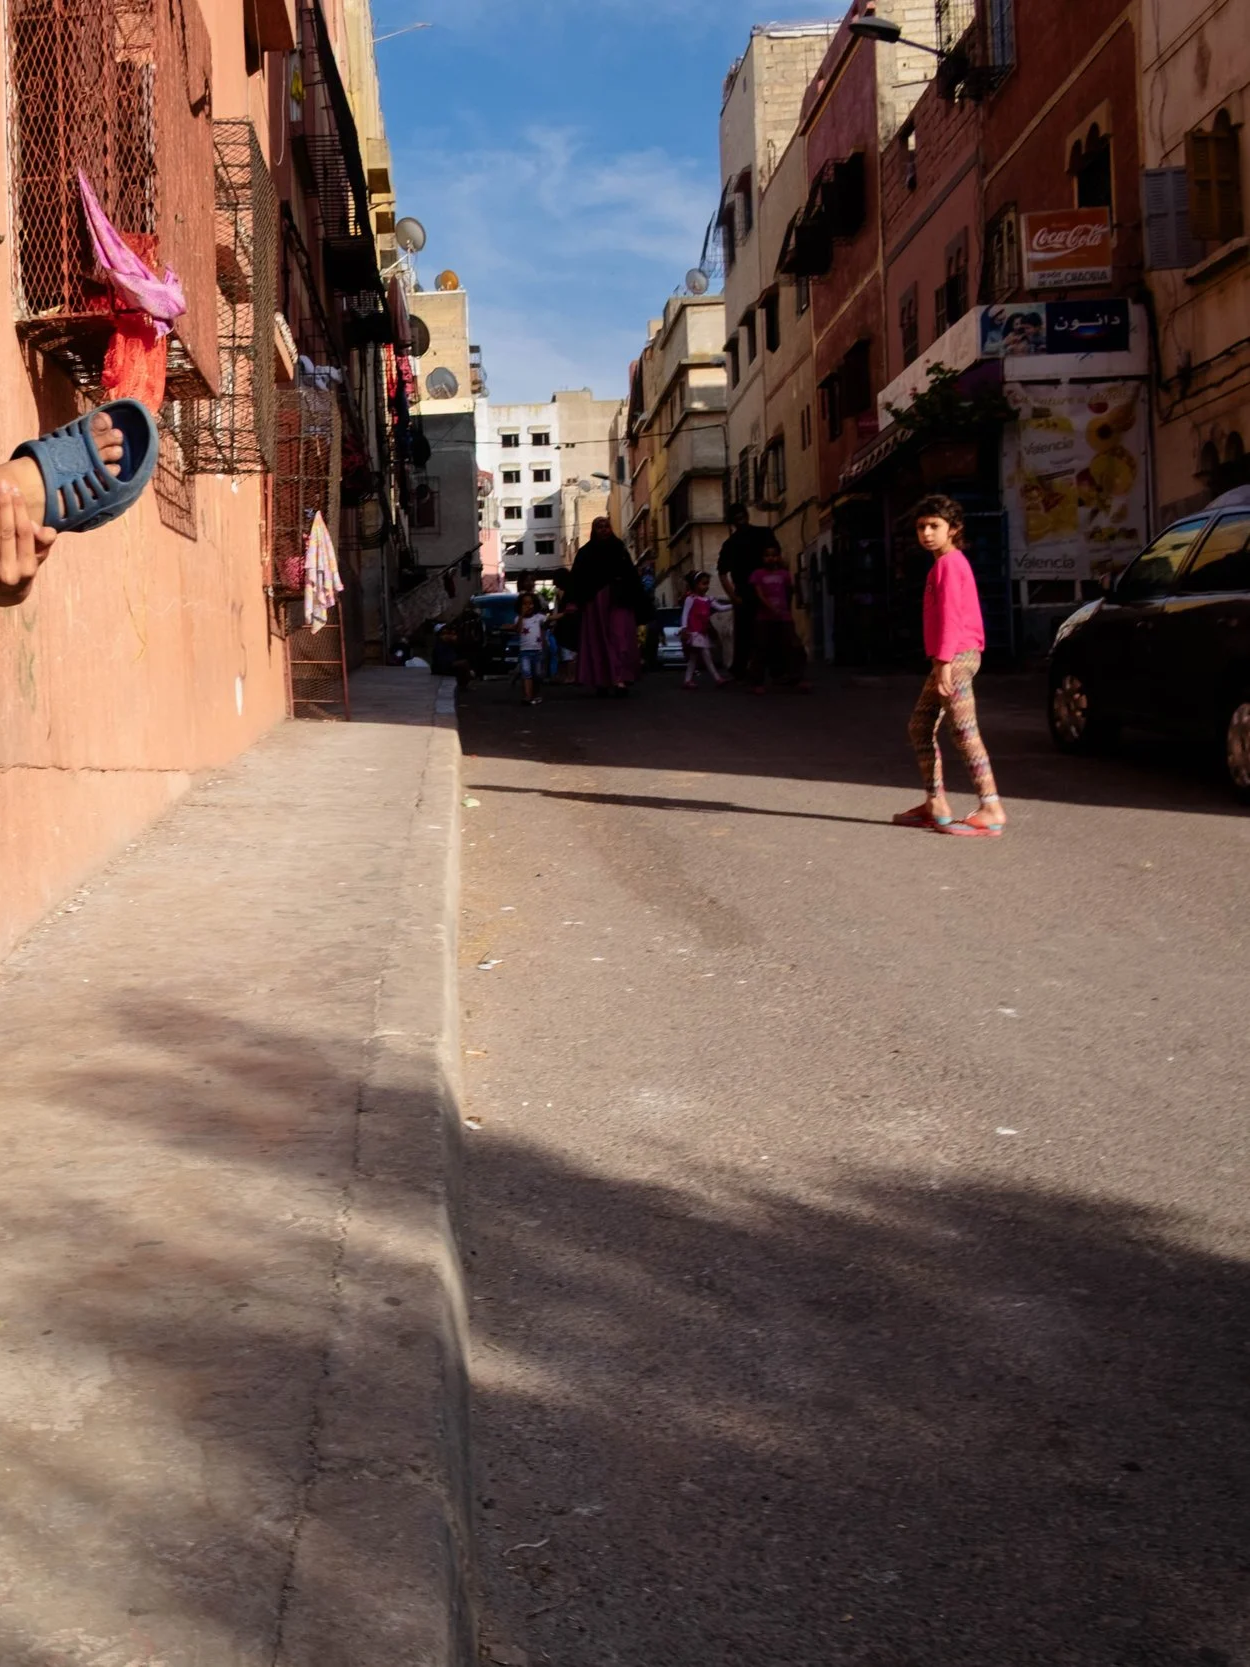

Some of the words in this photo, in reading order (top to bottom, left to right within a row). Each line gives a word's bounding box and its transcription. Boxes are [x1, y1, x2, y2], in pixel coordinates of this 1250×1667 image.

[1032, 223, 1109, 251] Coca-Cola
[1024, 437, 1074, 455] Valencia
[1014, 552, 1075, 569] Valencia
